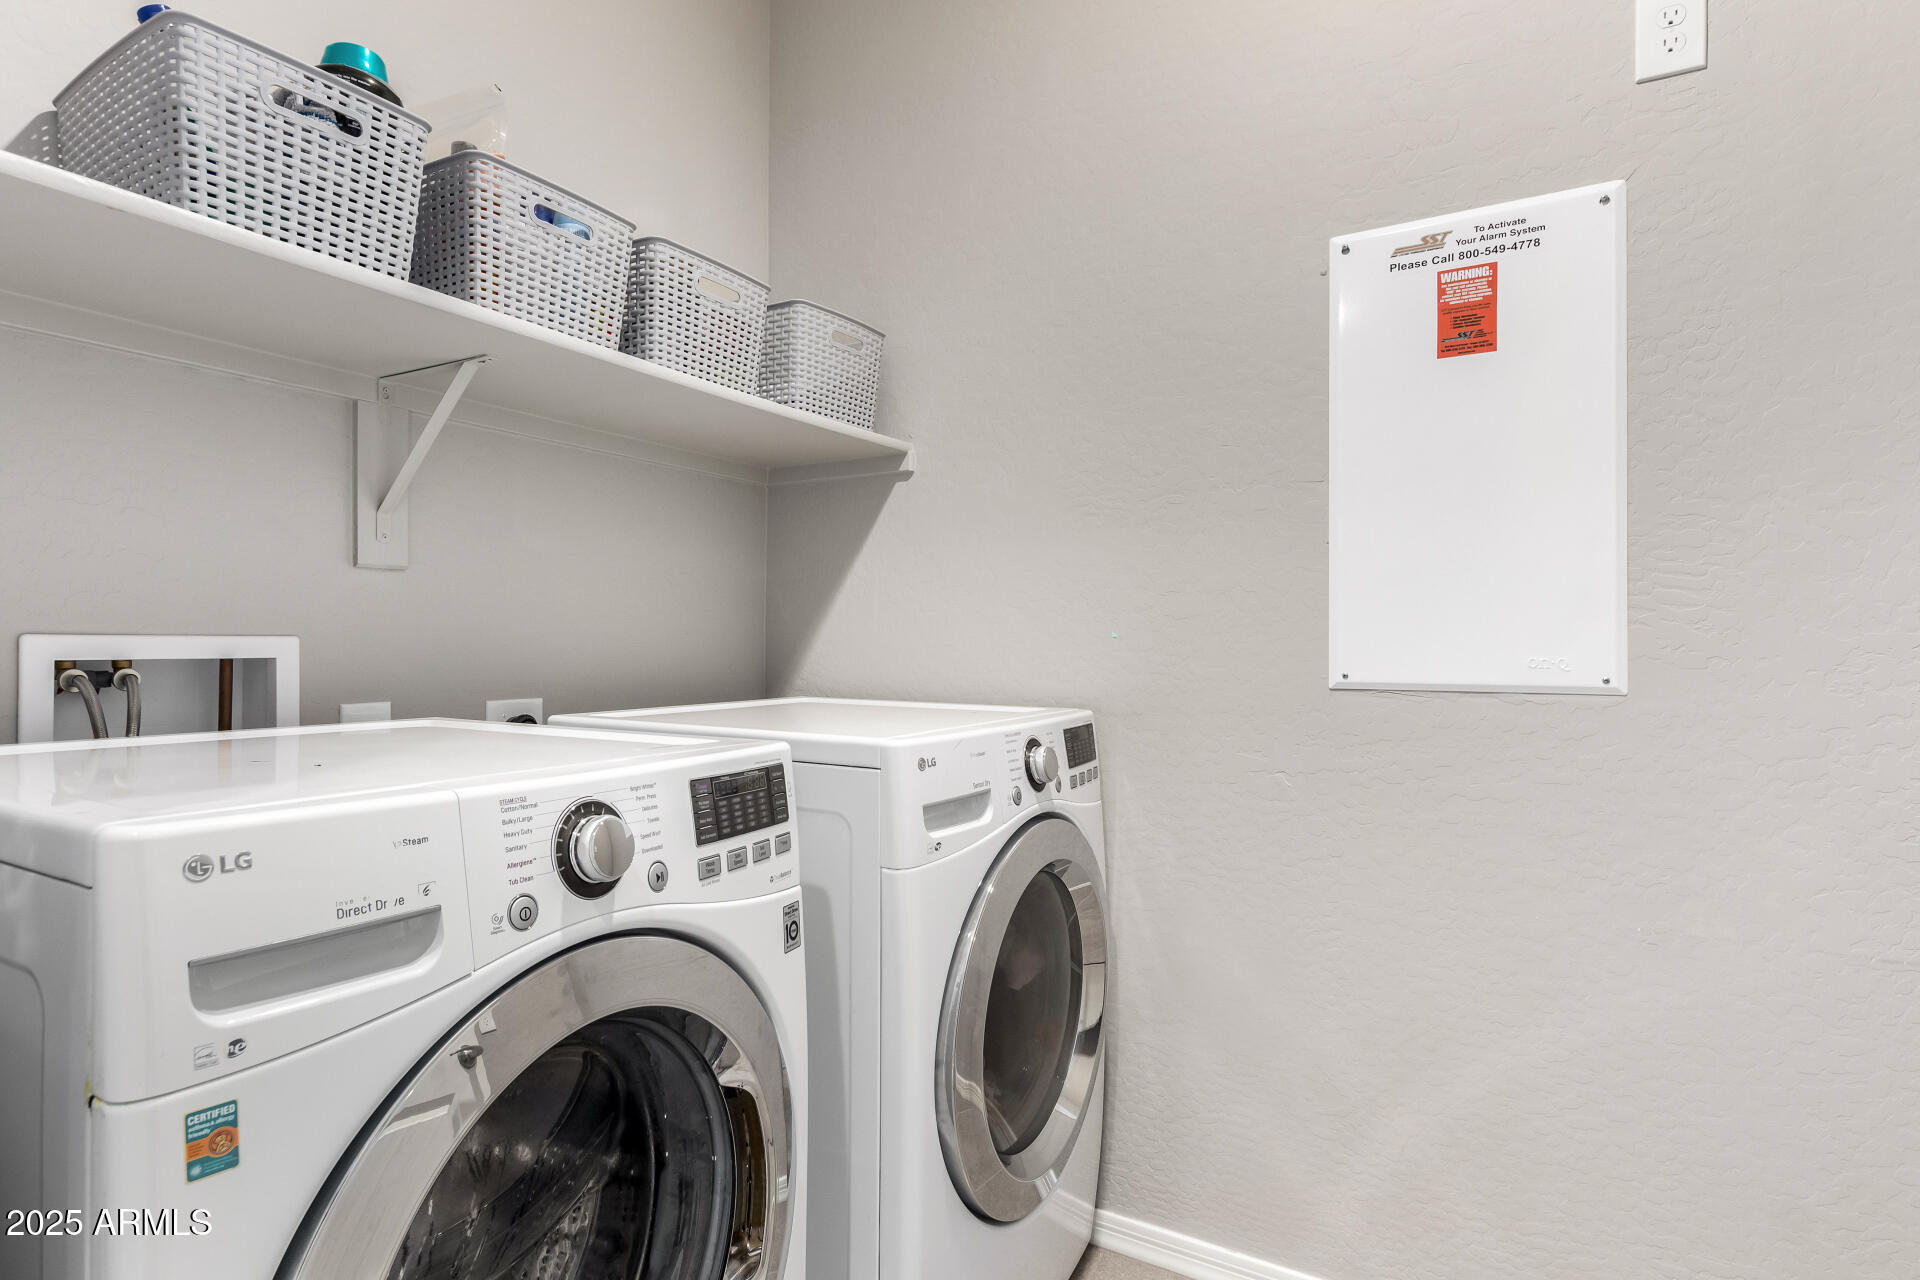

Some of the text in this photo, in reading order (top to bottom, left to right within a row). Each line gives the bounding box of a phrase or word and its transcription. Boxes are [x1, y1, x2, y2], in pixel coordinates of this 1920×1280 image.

[1488, 218, 1527, 230] Activate
[1456, 224, 1546, 247] Your Alarm System
[1389, 259, 1428, 273] Please
[1431, 253, 1455, 265] Call
[1458, 238, 1541, 261] 800-549-4778
[1440, 266, 1493, 284] WARNING:
[926, 756, 937, 768] LG
[503, 830, 520, 839] Heavy
[505, 844, 527, 853] Sanitary
[219, 850, 254, 875] LG
[508, 875, 534, 887] Tub Clean
[336, 900, 372, 920] Direct
[187, 1103, 236, 1126] CERTIFIED
